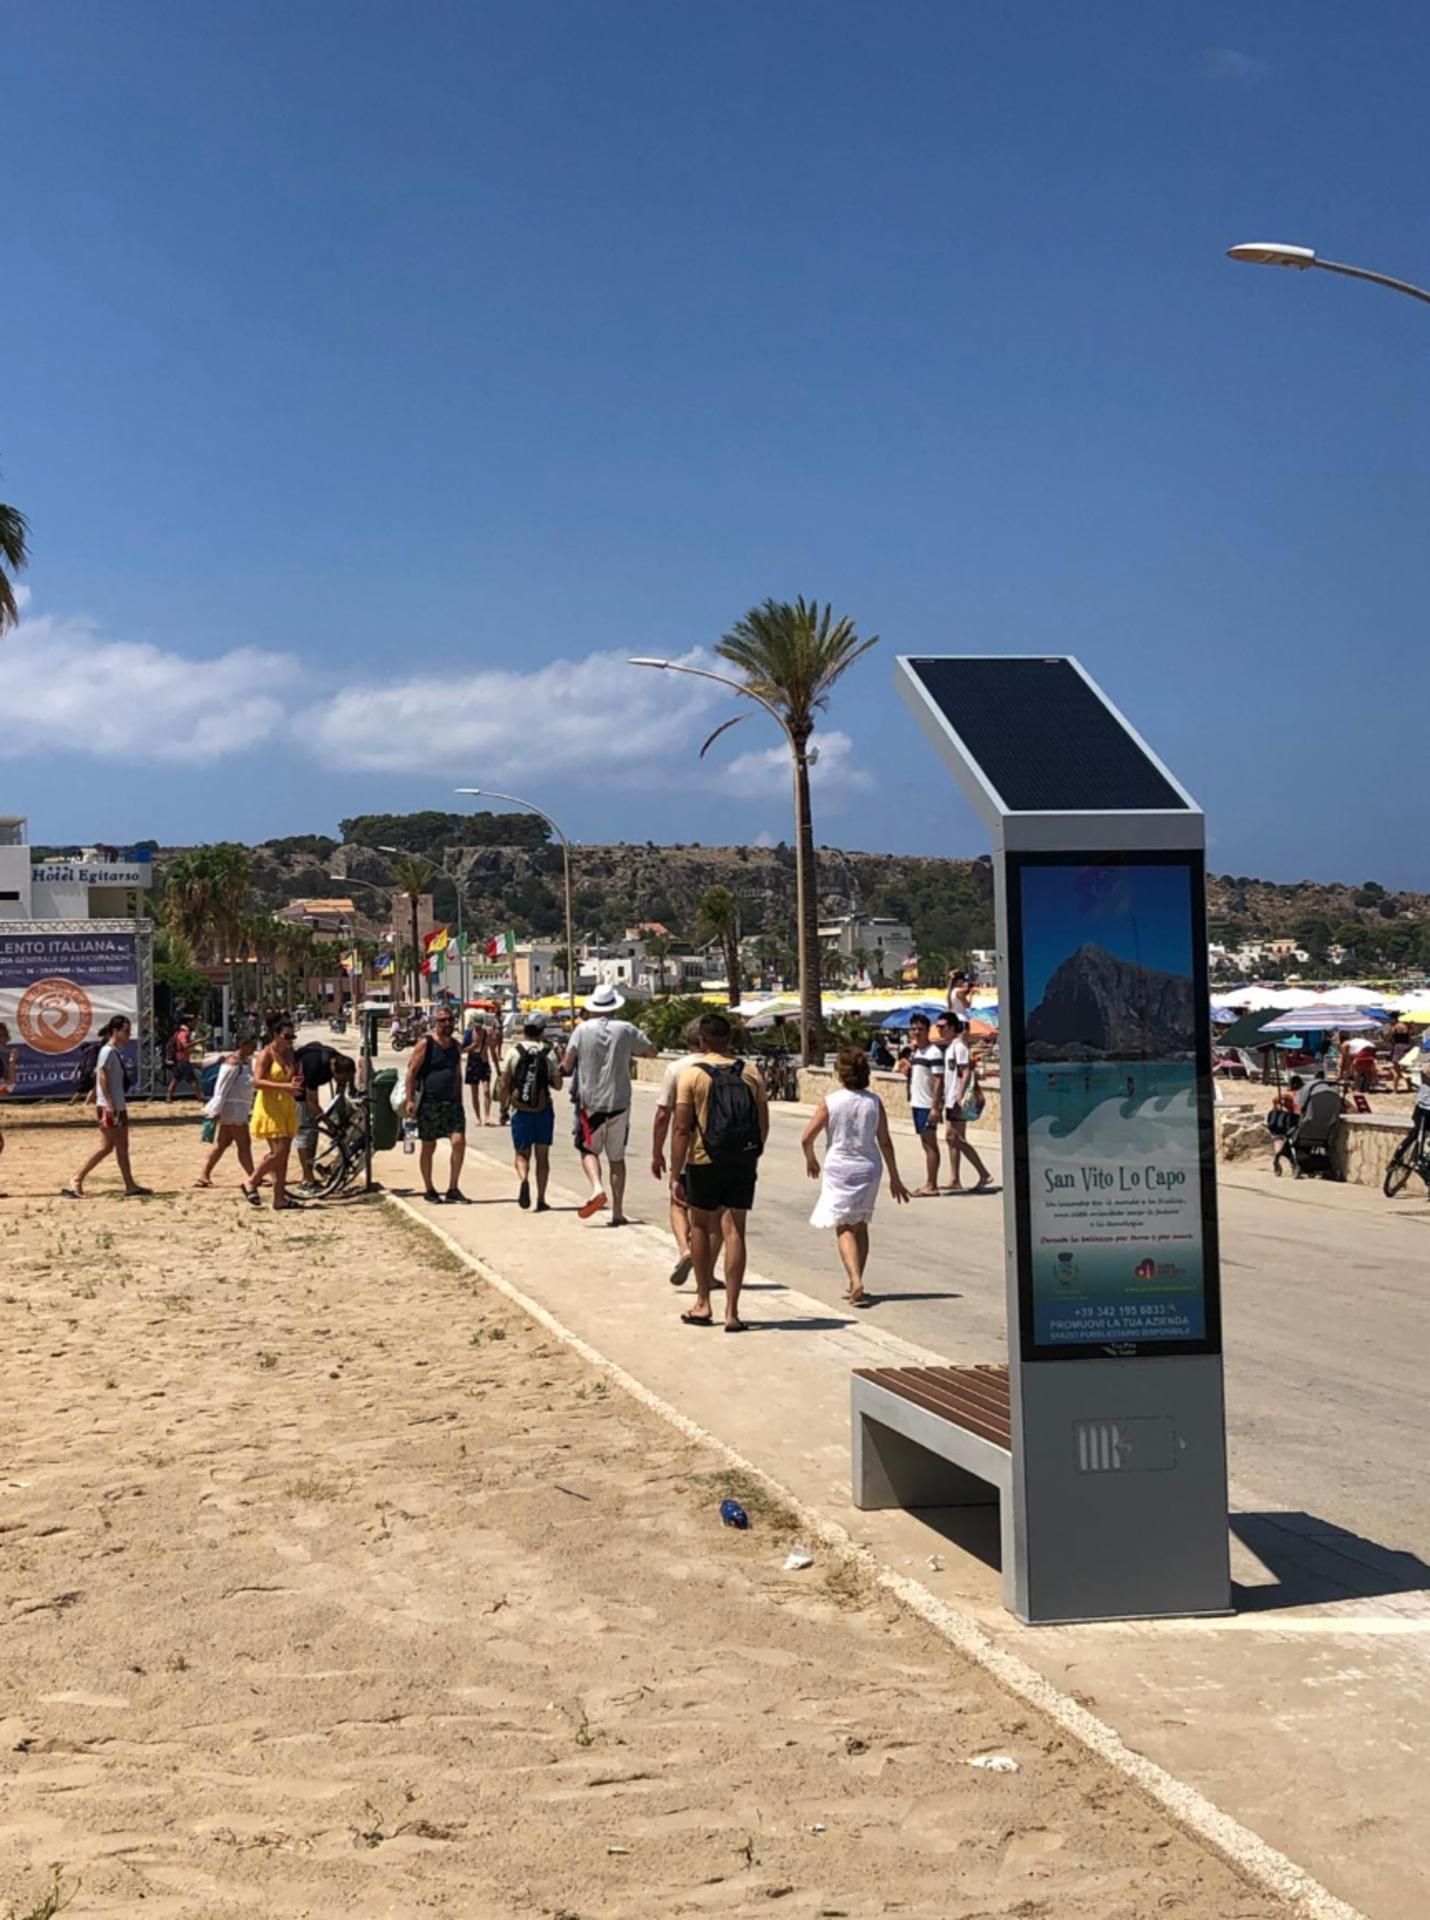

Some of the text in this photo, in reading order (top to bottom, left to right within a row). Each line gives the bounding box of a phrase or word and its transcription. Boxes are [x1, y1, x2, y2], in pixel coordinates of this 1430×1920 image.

[32, 869, 140, 884] Hotel Egitarso
[49, 939, 116, 953] ITALIANA
[16, 1072, 38, 1082] ITO
[40, 1071, 58, 1081] LO
[1044, 1165, 1186, 1193] San Vito Lo Capo
[1074, 1306, 1094, 1317] +39
[1097, 1305, 1115, 1317] 342
[1049, 1315, 1190, 1330] PROMUOVI LA TUA AZIENDA
